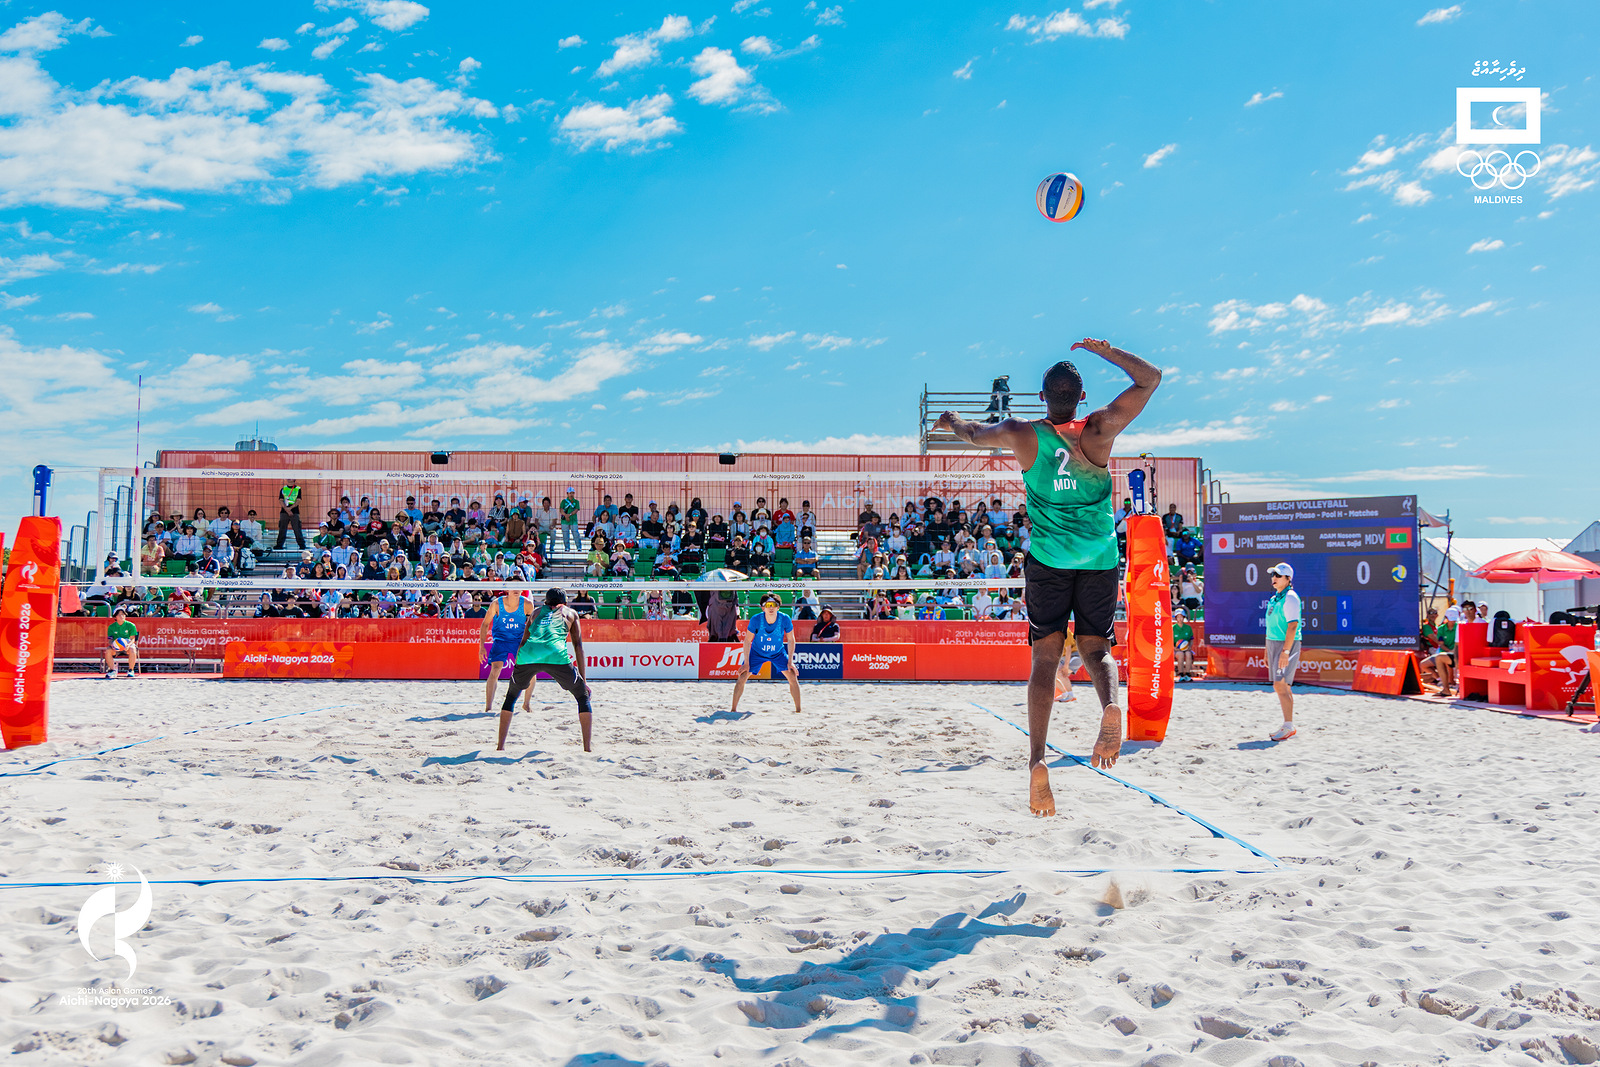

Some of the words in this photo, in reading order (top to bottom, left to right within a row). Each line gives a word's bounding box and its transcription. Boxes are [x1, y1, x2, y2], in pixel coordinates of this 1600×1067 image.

[1055, 447, 1070, 476] 2
[201, 470, 239, 478] Aichi-Nagoya
[1053, 478, 1077, 492] MDV
[1266, 502, 1295, 511] BEACH
[1296, 500, 1348, 510] VOLLEYBALL
[1258, 512, 1294, 521] Preliminary
[1348, 509, 1379, 517] Matches
[1235, 537, 1254, 549] JPN
[1364, 533, 1385, 545] MDV
[1245, 563, 1258, 586] 0
[1356, 560, 1371, 585] 0
[200, 579, 238, 587] Aichi-Nagoya
[935, 580, 971, 588] Aichi-Nagoya
[1311, 600, 1318, 610] 0
[1342, 600, 1347, 610] 1
[20, 602, 31, 630] 2026
[1311, 618, 1318, 628] 0
[1342, 618, 1348, 628] 0
[157, 627, 175, 635] 20th
[177, 627, 199, 635] Asian
[201, 627, 229, 635] Games
[139, 635, 216, 648] Aichi-Nagoya
[1353, 636, 1398, 646] Aichi-Nagoya
[761, 644, 776, 652] JPN
[243, 653, 308, 665] Aichi-Nagoya
[310, 655, 335, 663] 2026
[630, 655, 695, 667] TOYOTA
[716, 647, 745, 669] JT
[792, 652, 840, 663] ORNAN
[851, 654, 907, 664] Aichi-Nagoya
[14, 631, 31, 704] Aichi-Nagoya
[868, 662, 890, 670] 2026
[1150, 629, 1163, 699] Aichi-Nagoya
[1335, 659, 1358, 671] 202
